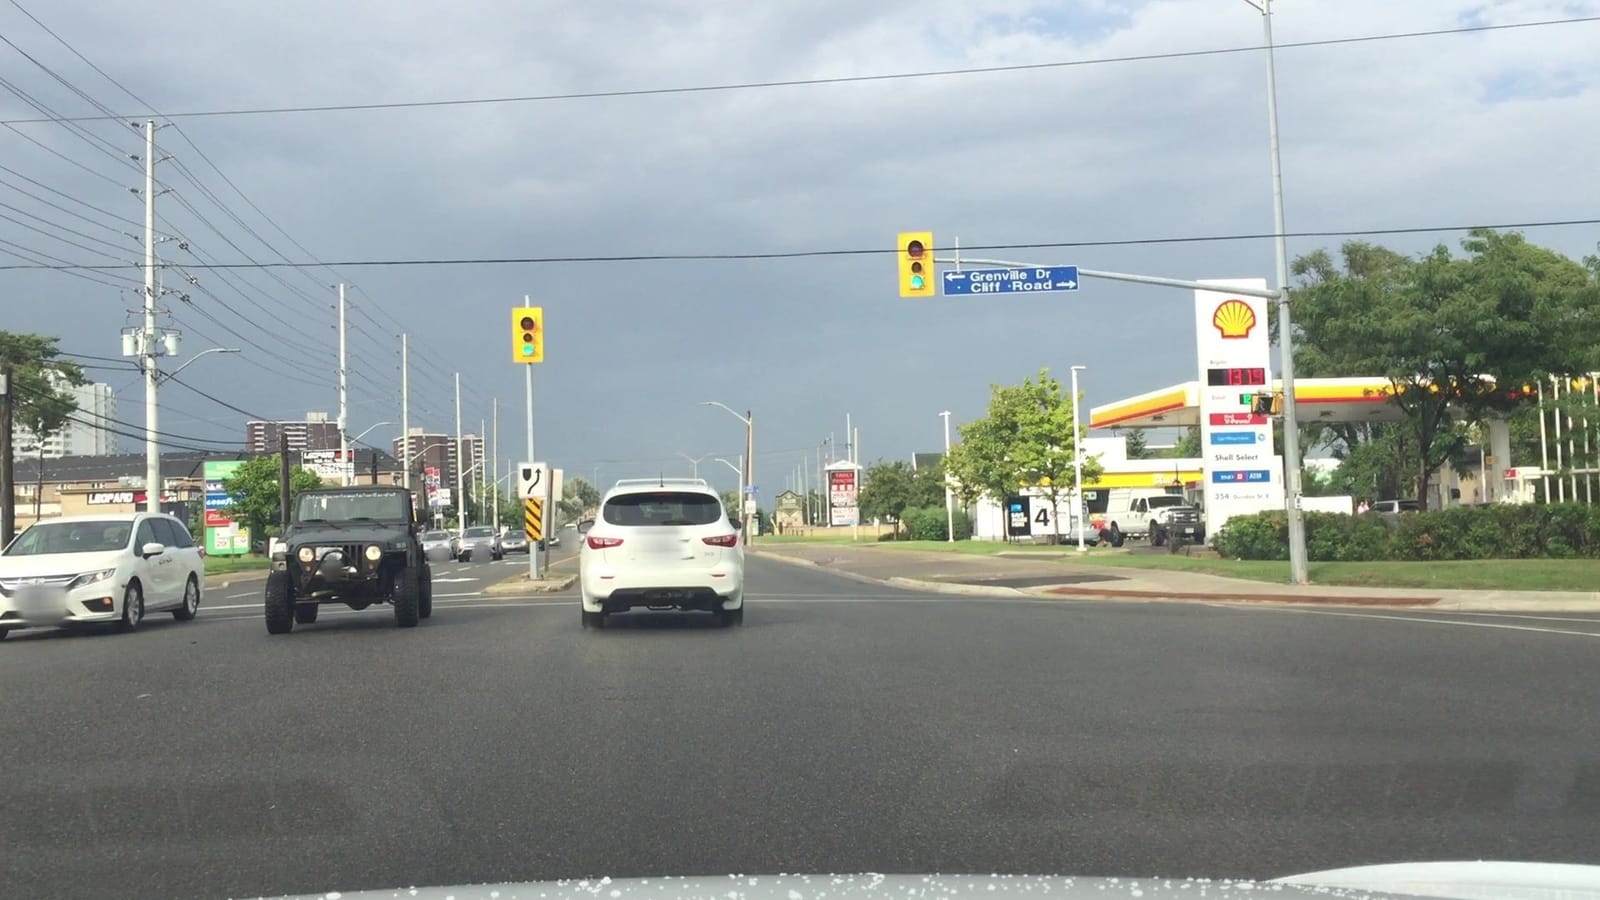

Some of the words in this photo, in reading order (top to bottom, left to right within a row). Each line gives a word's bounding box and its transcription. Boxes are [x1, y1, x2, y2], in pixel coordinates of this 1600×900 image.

[970, 270, 1027, 282] Grenville
[1036, 269, 1051, 280] Dr
[970, 282, 1000, 293] Cliff
[1012, 280, 1052, 291] Road
[1236, 453, 1258, 461] Select
[89, 492, 133, 504] LEOPARD
[1034, 508, 1050, 527] 4
